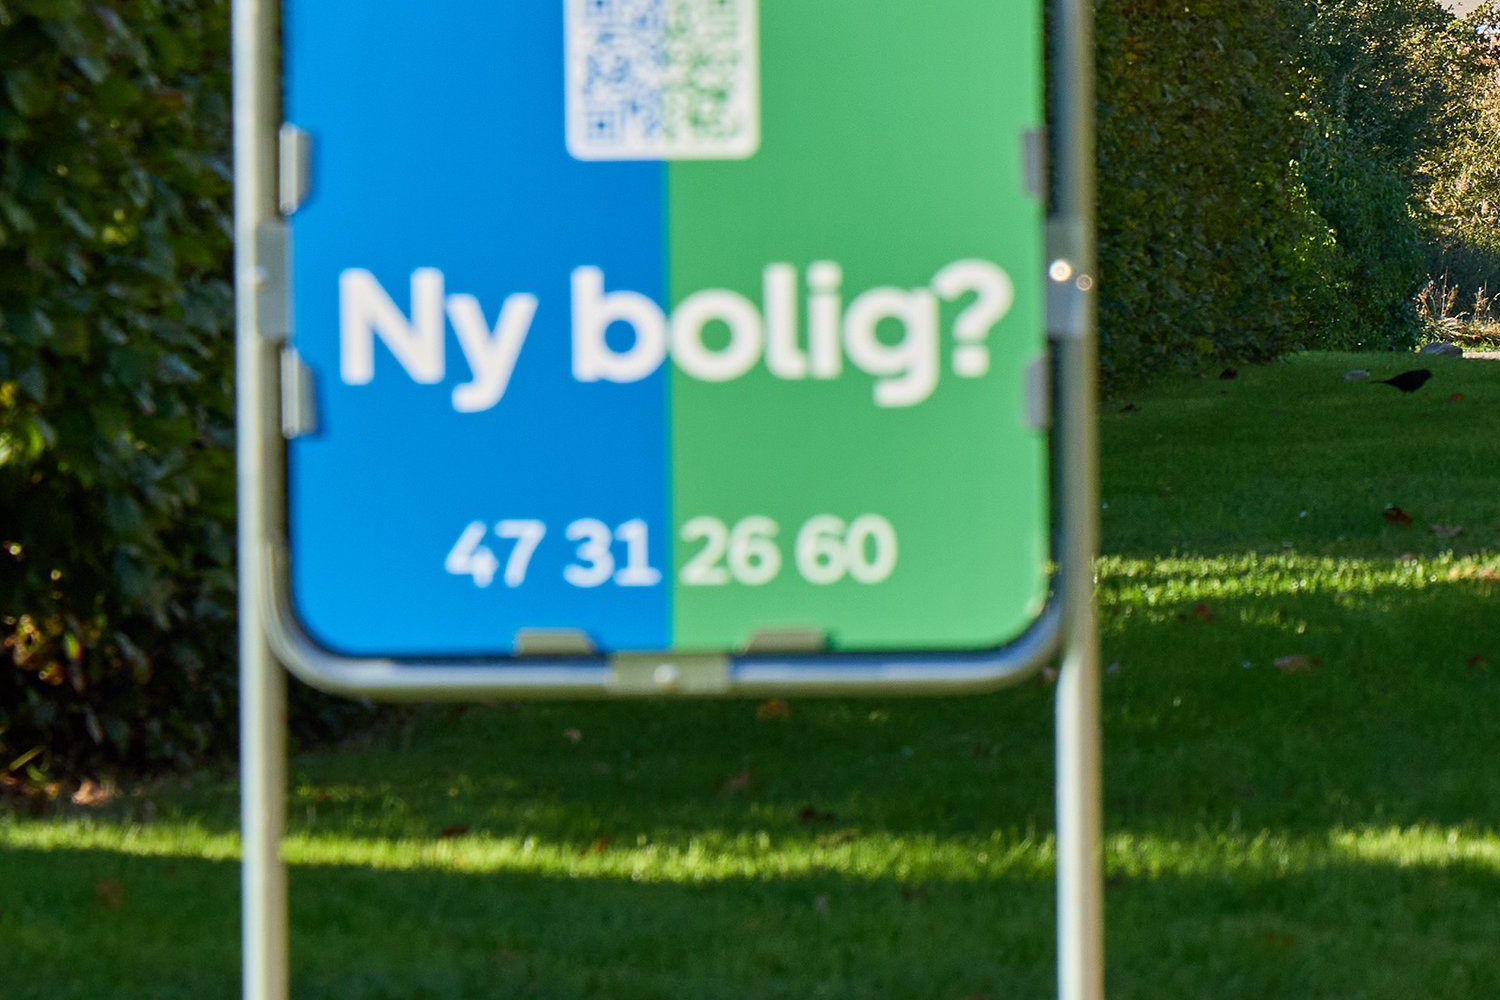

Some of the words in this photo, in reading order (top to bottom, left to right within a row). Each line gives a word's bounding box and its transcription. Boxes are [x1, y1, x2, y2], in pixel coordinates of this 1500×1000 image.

[339, 267, 538, 413] Ny
[570, 257, 1016, 410] bolig?
[445, 519, 547, 588] 47
[564, 518, 660, 588] 31
[678, 514, 784, 588] 26
[794, 512, 900, 588] 60
